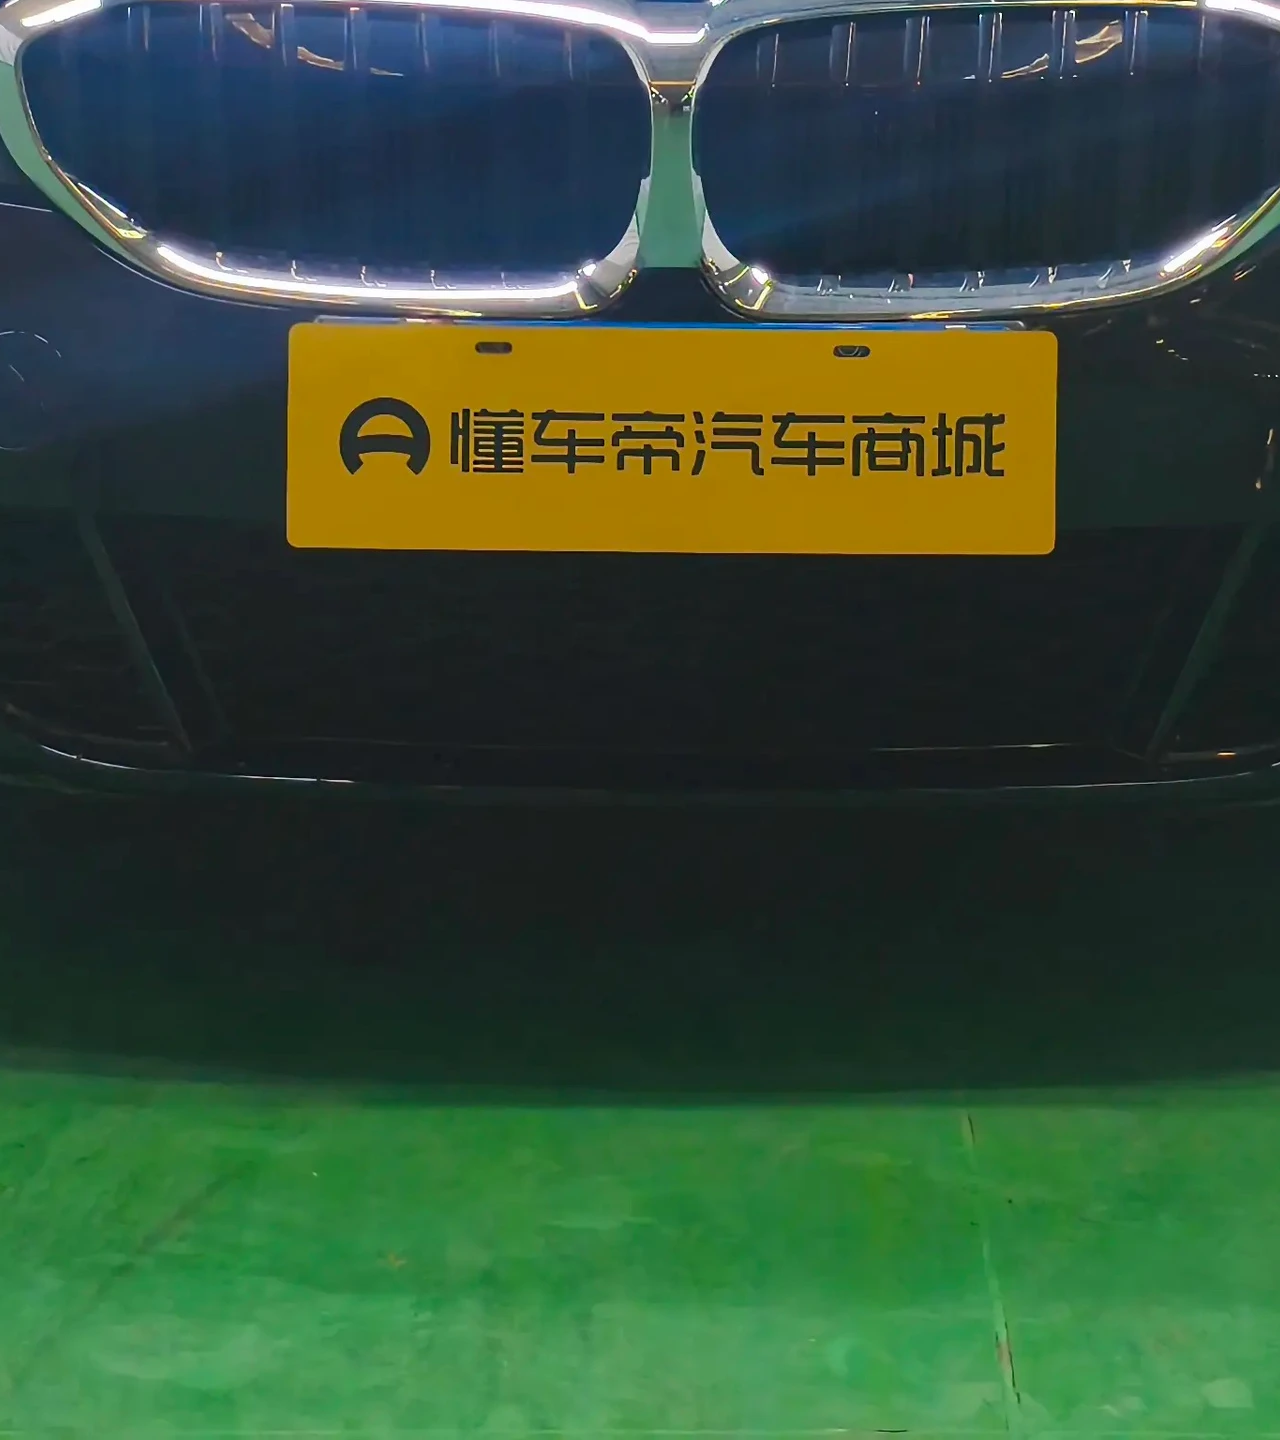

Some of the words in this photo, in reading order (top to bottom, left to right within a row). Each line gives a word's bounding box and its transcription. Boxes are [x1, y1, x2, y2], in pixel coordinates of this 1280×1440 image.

[450, 408, 1006, 477] 懂车帝汽车商城
